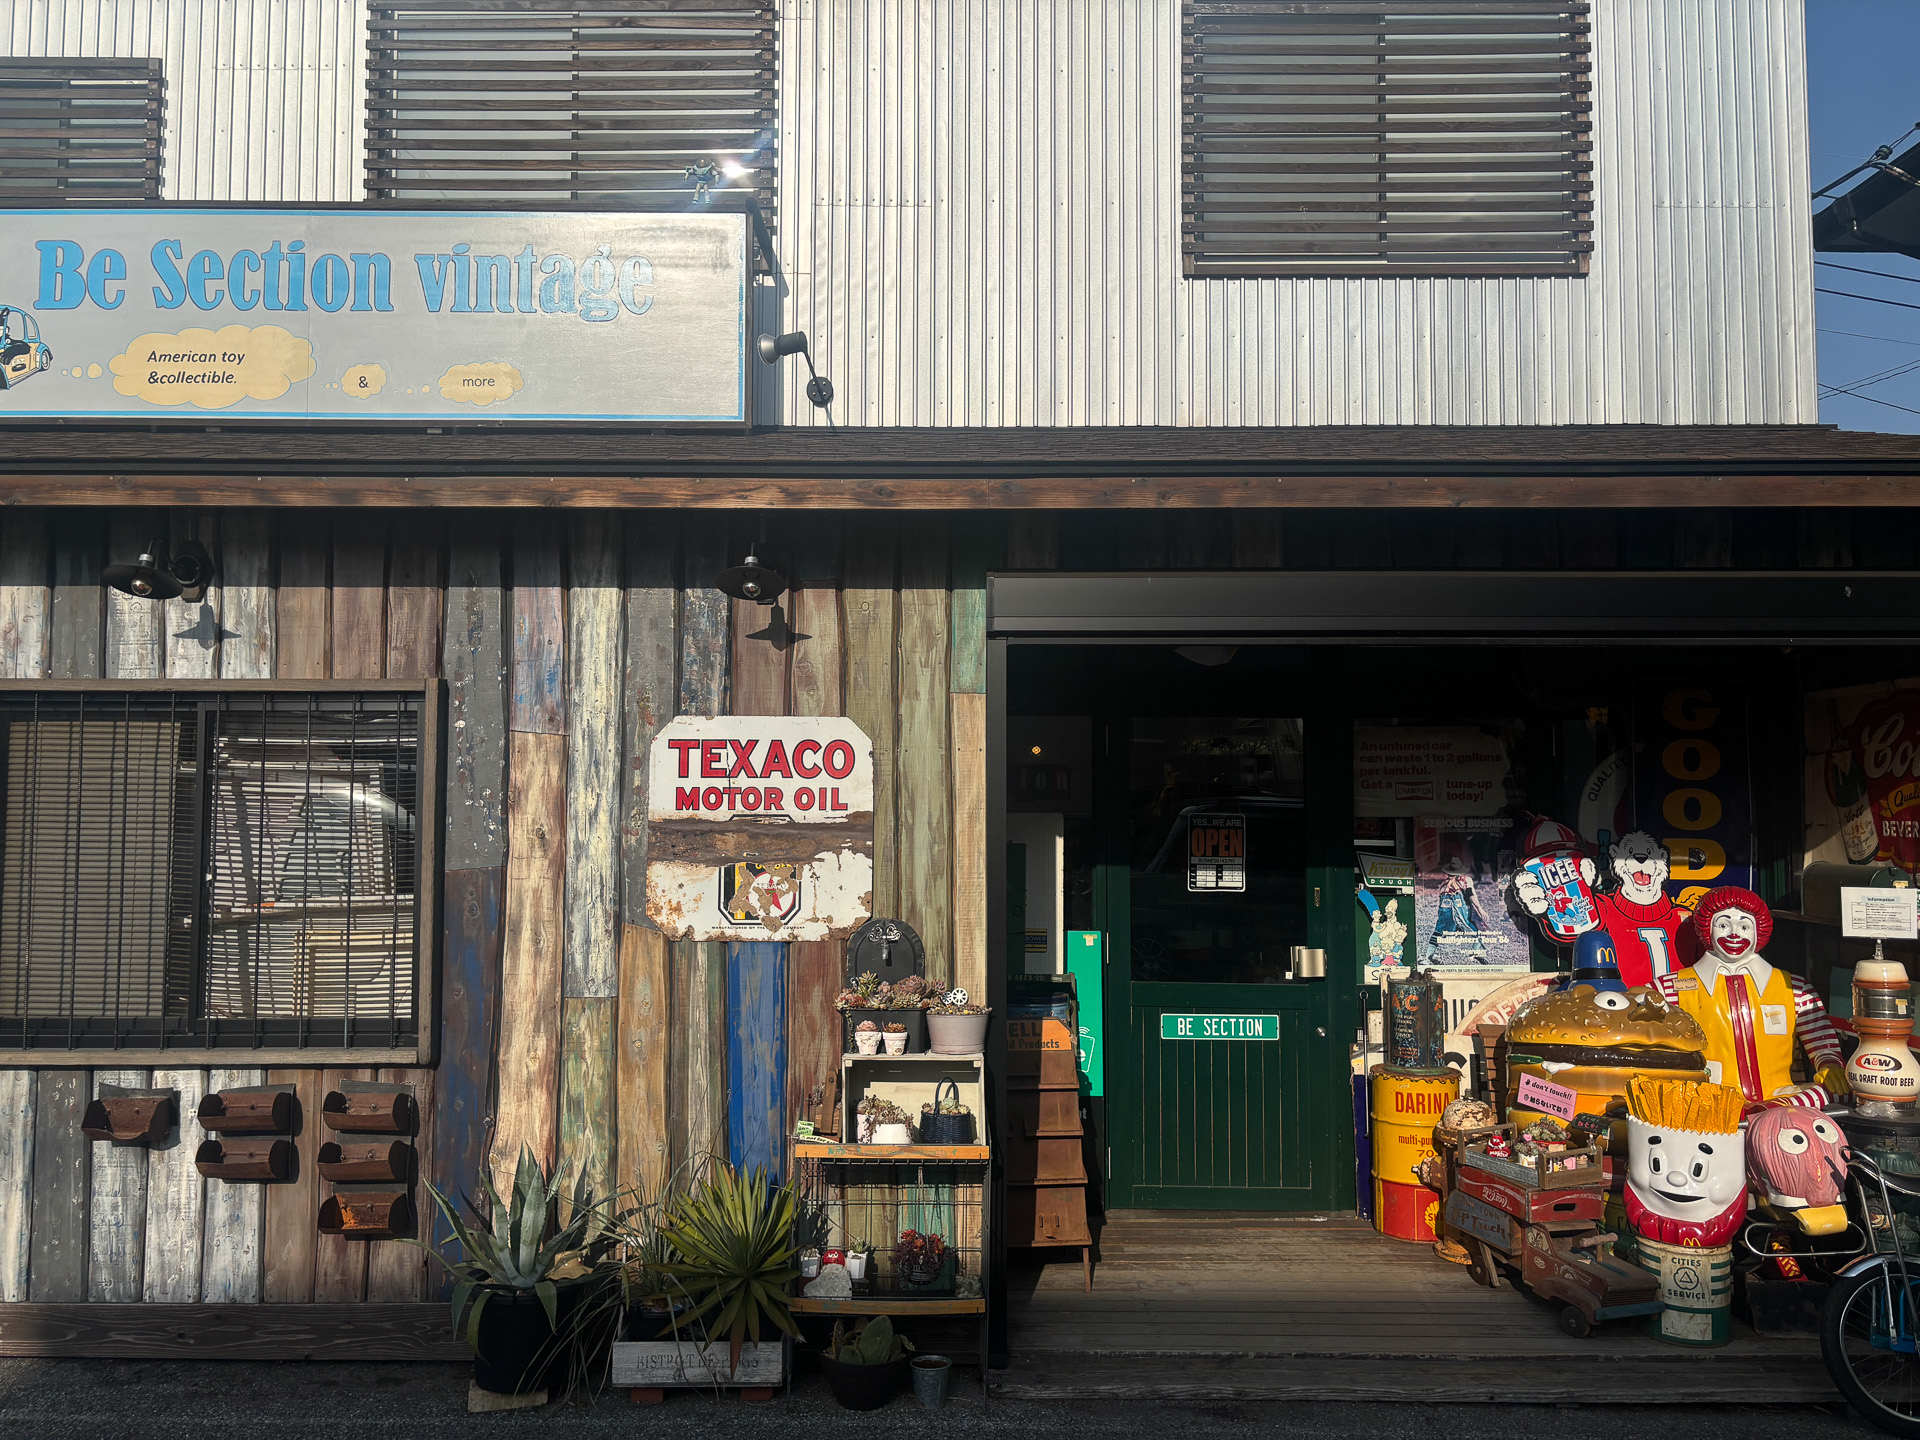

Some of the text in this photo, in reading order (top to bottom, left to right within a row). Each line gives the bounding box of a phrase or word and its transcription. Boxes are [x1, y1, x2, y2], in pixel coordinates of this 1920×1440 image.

[33, 239, 656, 323] Be Section vintage
[147, 350, 246, 369] American toy
[358, 374, 371, 390] &
[461, 376, 497, 388] more
[1359, 741, 1452, 752] An untuned car
[668, 739, 856, 779] TEXACO
[1359, 755, 1383, 763] can
[1384, 753, 1422, 763] waste
[1456, 752, 1502, 765] gallons
[1359, 767, 1381, 778] per
[1360, 779, 1383, 790] Get
[1446, 779, 1493, 792] tune-up
[676, 787, 849, 811] MOTOR OIL
[1446, 790, 1484, 803] today!
[1424, 818, 1514, 829] SERIOUS BUSINESS
[1191, 828, 1244, 858] OPEN
[1368, 861, 1408, 879] Krispy
[1538, 857, 1581, 891] ICEE
[1437, 935, 1479, 945] Bullfighters
[1481, 935, 1498, 944] Tour
[1177, 1018, 1263, 1036] BE SECTION
[1863, 1057, 1891, 1067] A&W
[1859, 1074, 1877, 1084] DRAFT
[1880, 1076, 1898, 1086] ROOT
[1900, 1077, 1915, 1087] BEER
[1531, 1081, 1573, 1102] don't touch!!
[1671, 1256, 1702, 1267] CITIES
[1667, 1288, 1706, 1300] SERVICE
